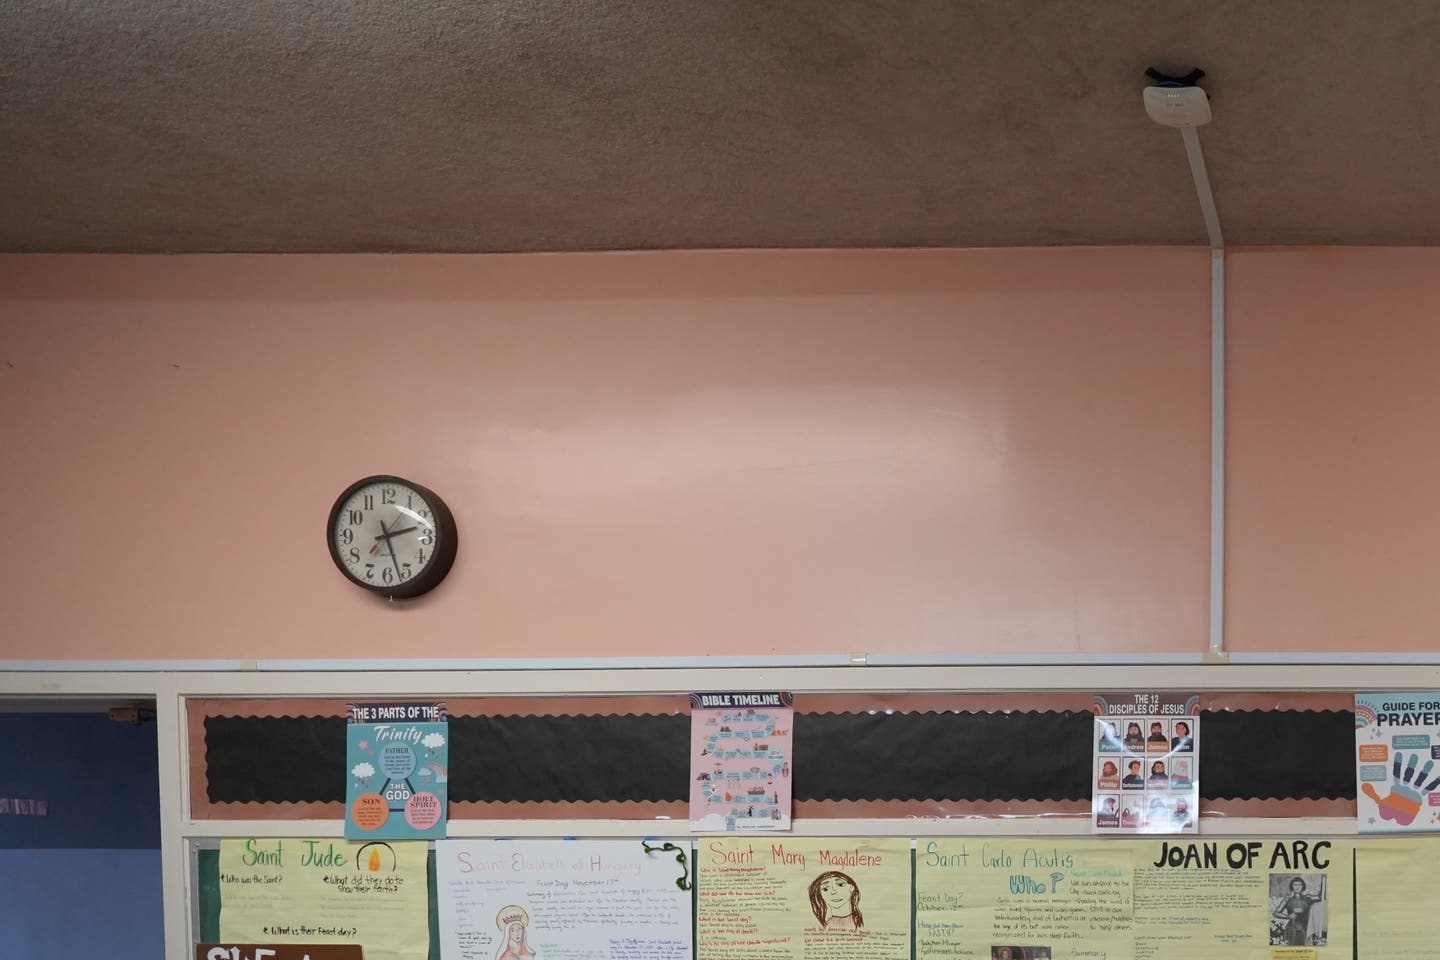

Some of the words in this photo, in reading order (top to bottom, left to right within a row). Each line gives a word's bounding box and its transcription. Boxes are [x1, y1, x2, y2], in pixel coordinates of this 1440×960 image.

[364, 495, 374, 510] 11
[382, 488, 396, 505] 12
[406, 495, 412, 509] 1
[349, 510, 363, 526] 10
[342, 528, 353, 545] 9
[421, 529, 433, 545] 3
[349, 547, 360, 564] 8
[415, 548, 425, 564] 4
[365, 563, 375, 579] 7
[382, 567, 393, 584] 6
[401, 563, 411, 579] 5
[701, 694, 731, 706] BIBLE
[732, 694, 780, 705] TIMELINE
[1134, 694, 1149, 704] THE
[1150, 694, 1159, 704] 12
[1382, 702, 1415, 712] GUIDE
[1418, 702, 1440, 711] FOR
[352, 708, 369, 720] THE
[371, 707, 377, 719] 3
[378, 707, 406, 719] PARTS
[407, 707, 420, 718] OF
[421, 706, 439, 718] THE
[1109, 704, 1147, 714] DISCIPLES
[1148, 704, 1159, 714] OF
[1160, 704, 1184, 714] JESUS
[374, 725, 422, 745] Trinity
[386, 790, 410, 800] GOD
[242, 838, 285, 868] Saint
[301, 840, 348, 868] Jude
[710, 842, 754, 865] Saint
[771, 844, 806, 870] Mary
[819, 849, 883, 870] Magdalene
[926, 841, 969, 868] Saint
[982, 842, 1012, 868] Carlo
[1023, 847, 1074, 868] Acutis
[1154, 842, 1217, 869] JOAN
[1226, 842, 1263, 869] OF
[1269, 840, 1331, 869] ARC
[457, 851, 505, 873] Saint
[329, 876, 349, 885] What
